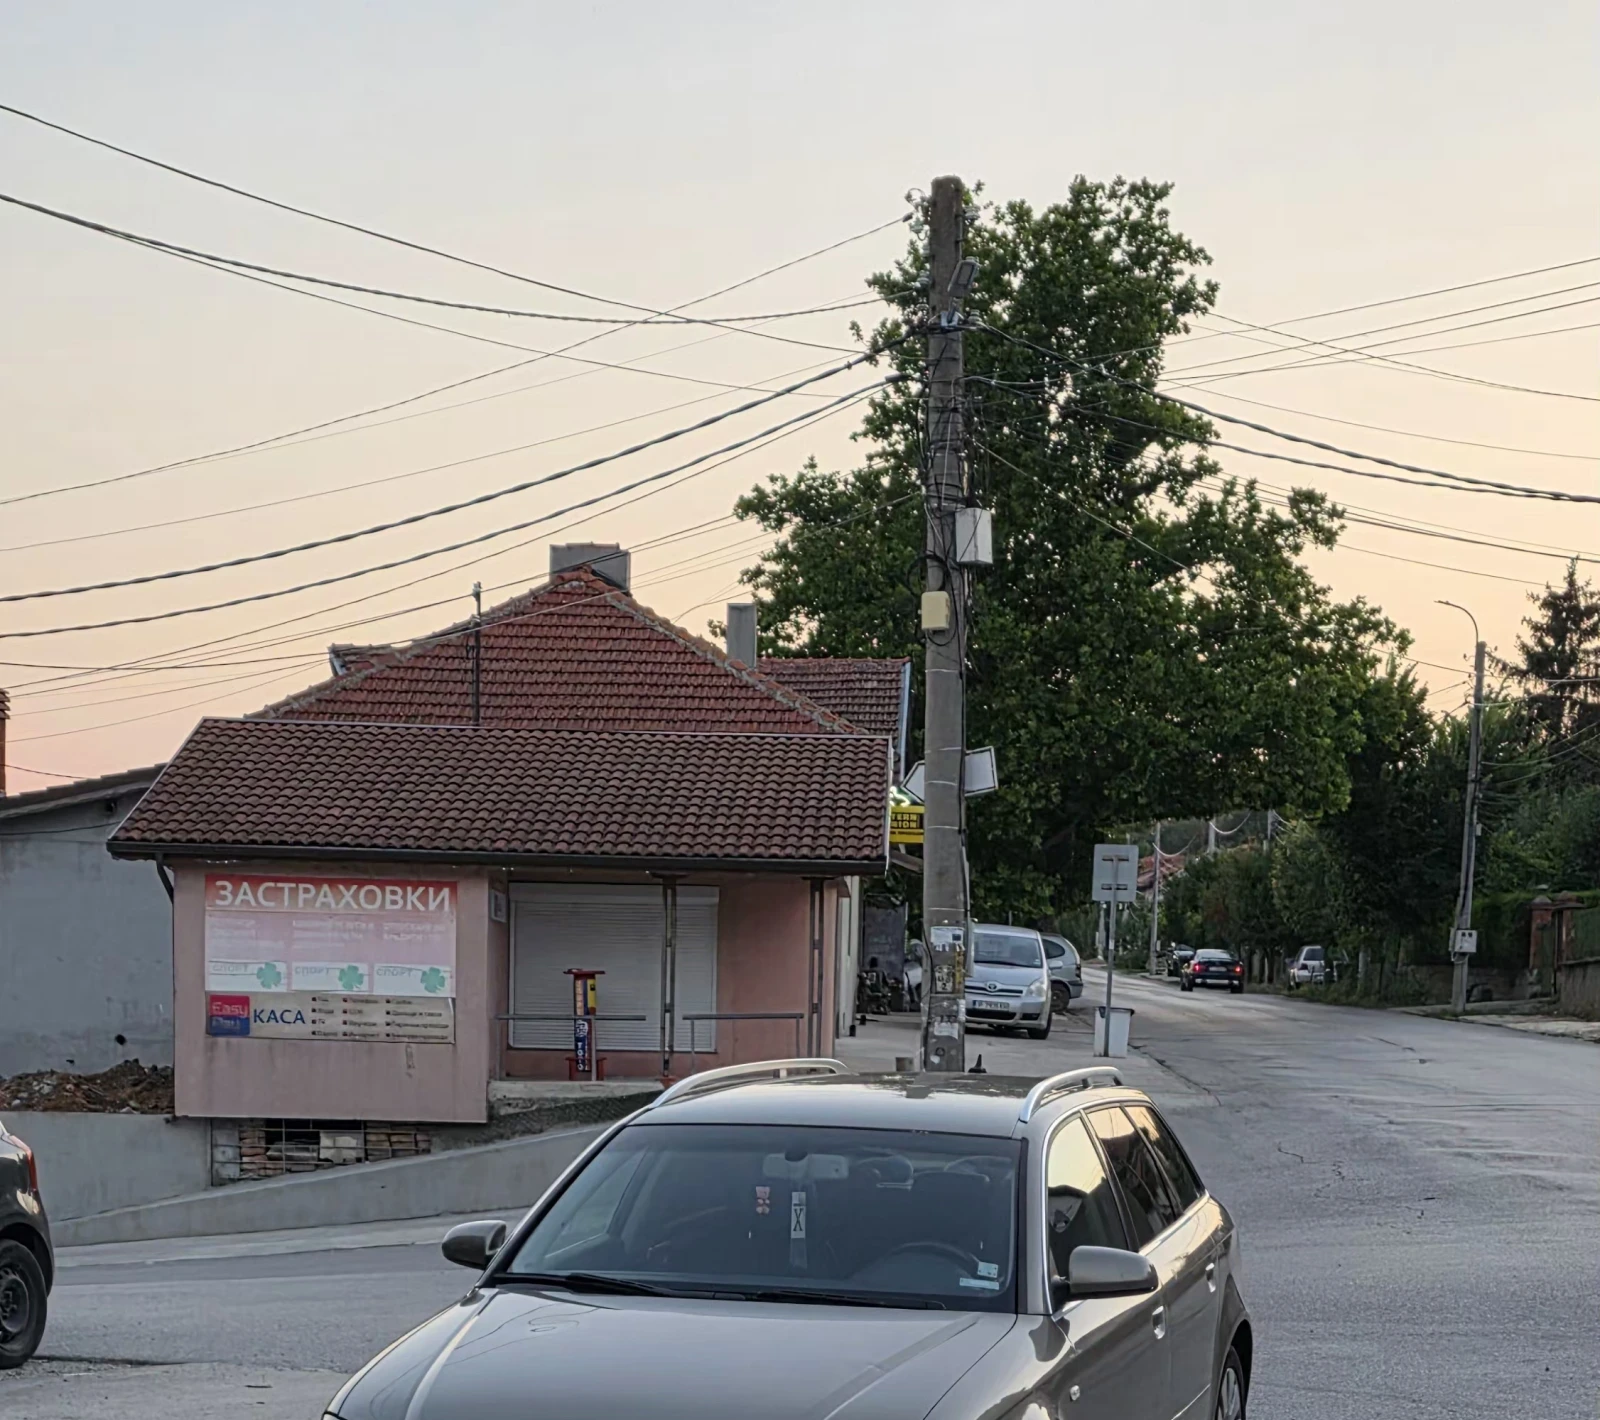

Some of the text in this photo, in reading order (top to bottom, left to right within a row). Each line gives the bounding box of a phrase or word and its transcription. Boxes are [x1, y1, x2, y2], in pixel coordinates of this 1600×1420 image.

[215, 880, 450, 911] ЗАСТРАХОВКИ
[211, 1001, 249, 1018] Easy
[253, 1008, 306, 1024] КАСА
